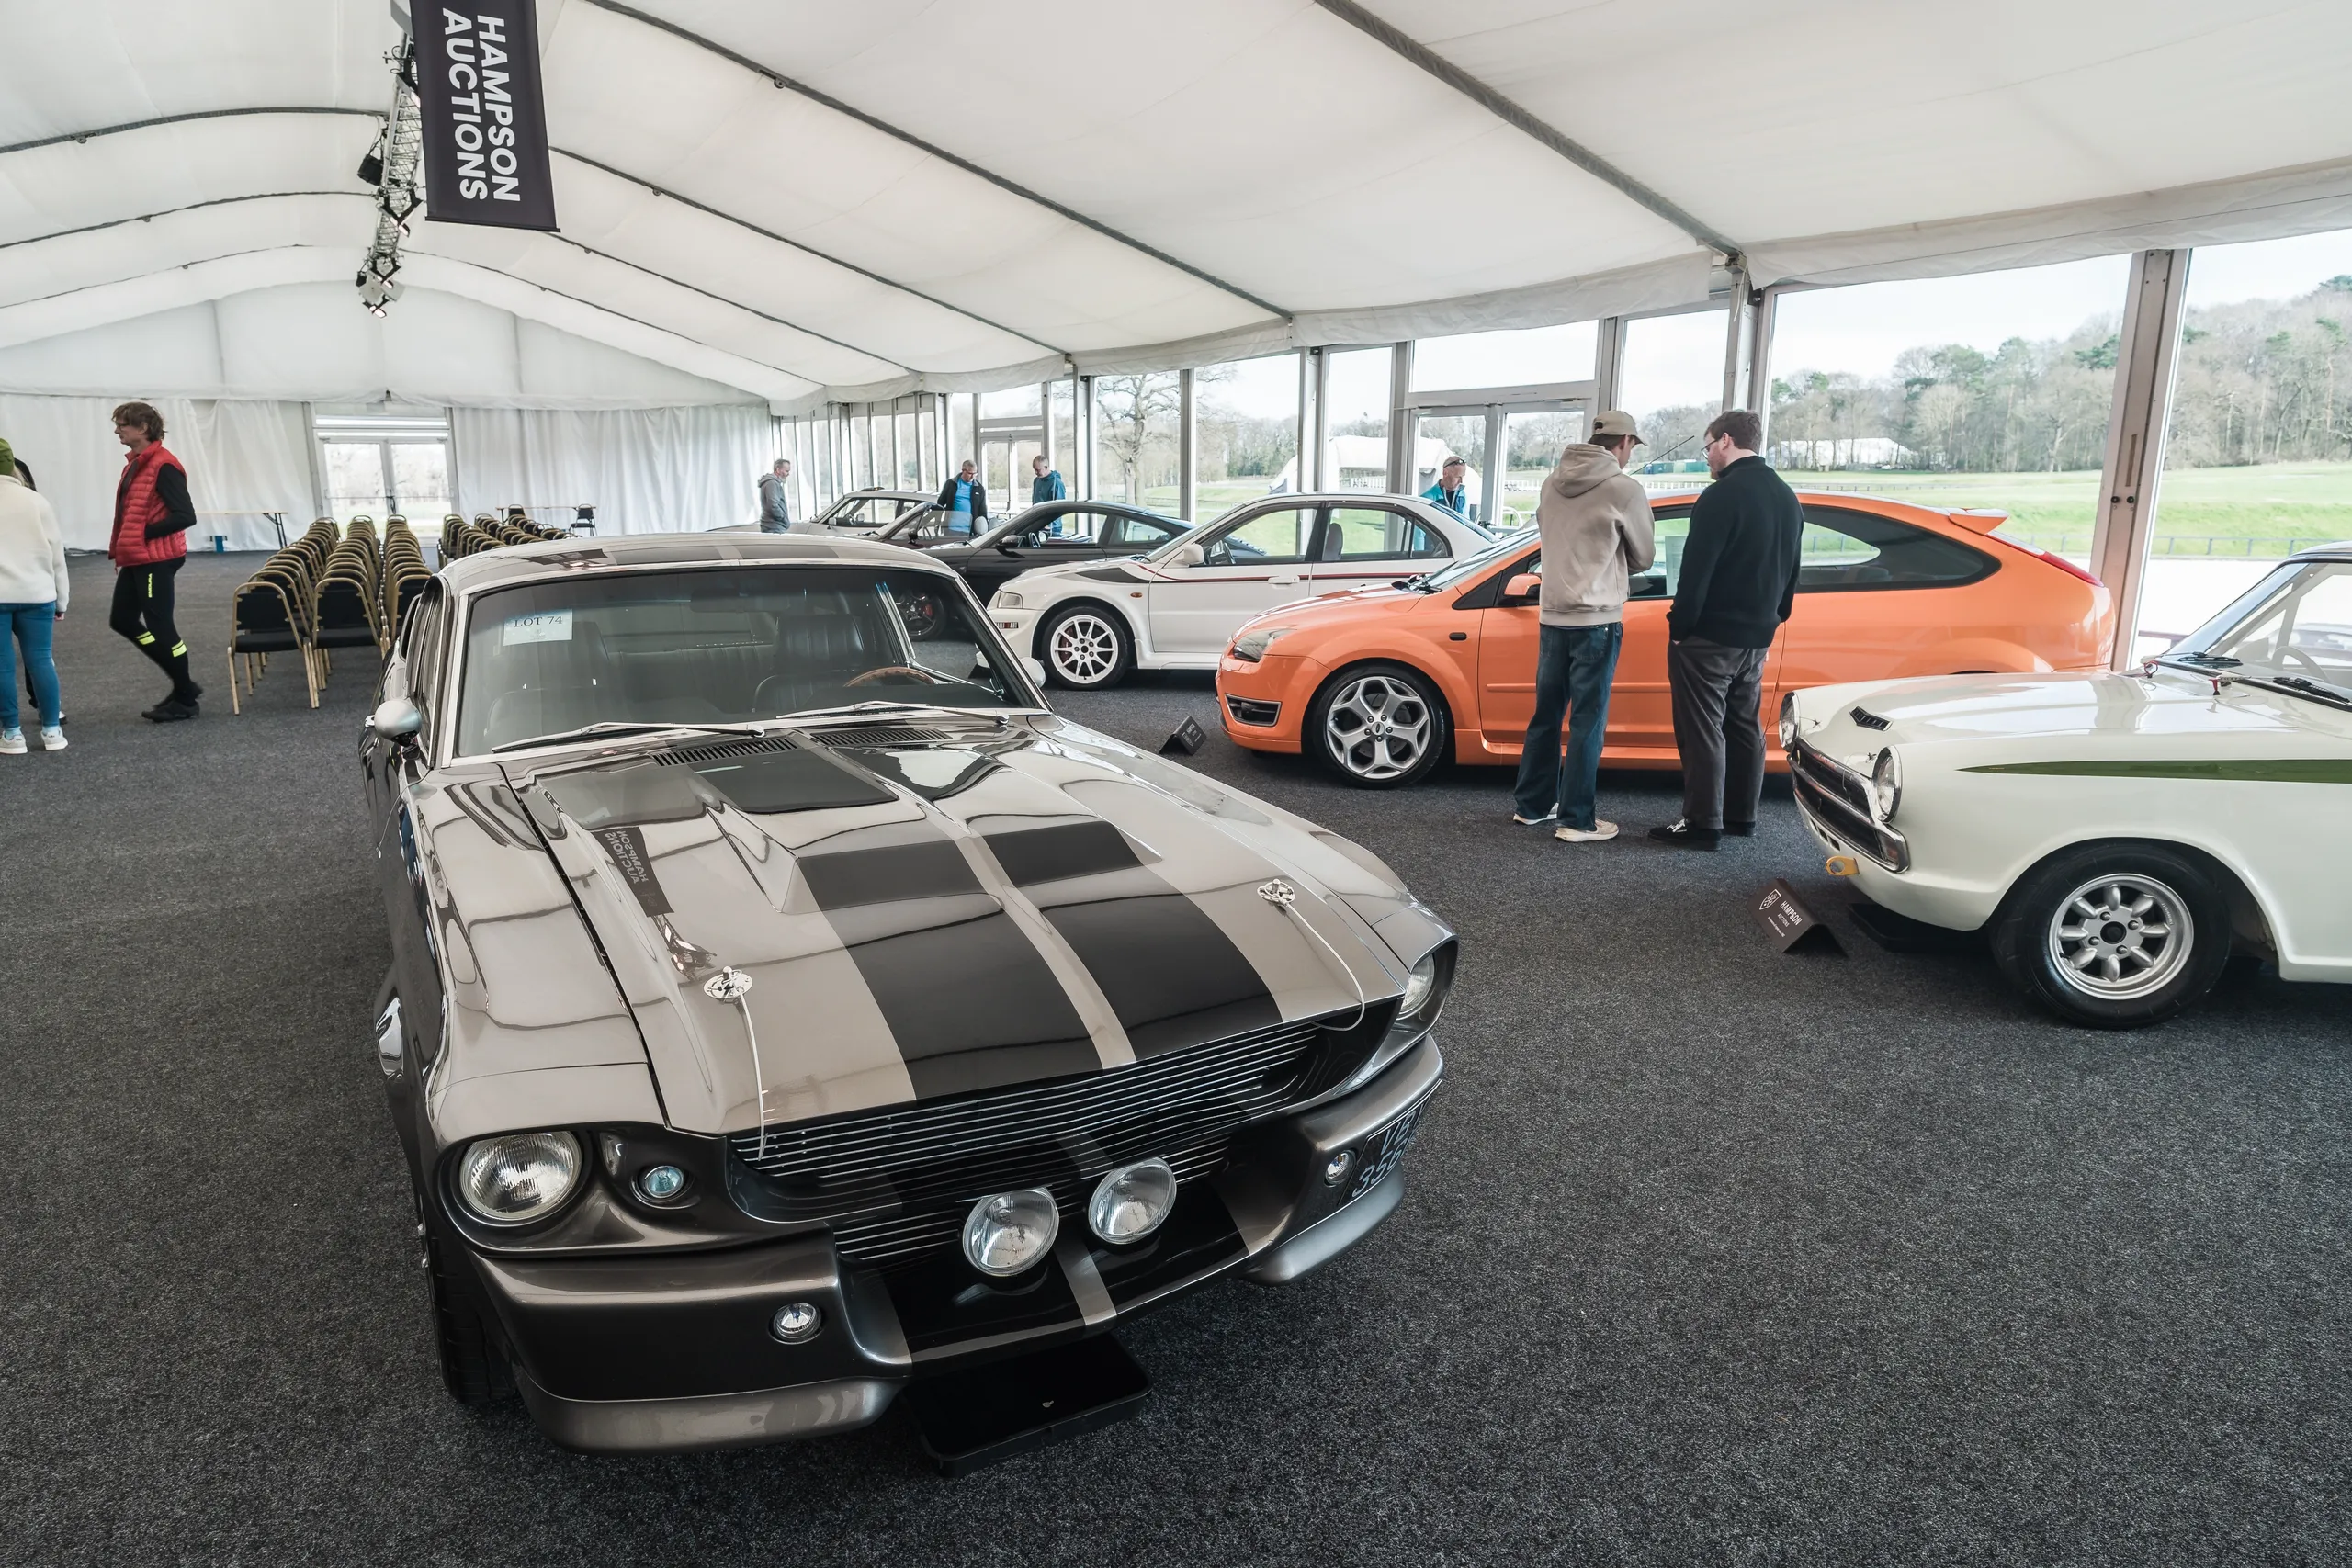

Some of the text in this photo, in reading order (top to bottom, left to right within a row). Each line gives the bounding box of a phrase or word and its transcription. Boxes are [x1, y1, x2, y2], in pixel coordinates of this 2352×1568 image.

[442, 7, 488, 200] AUCTIONS
[477, 15, 521, 201] HAMPSON
[514, 615, 563, 628] LOT 74
[1780, 900, 1803, 926] HAMPSON
